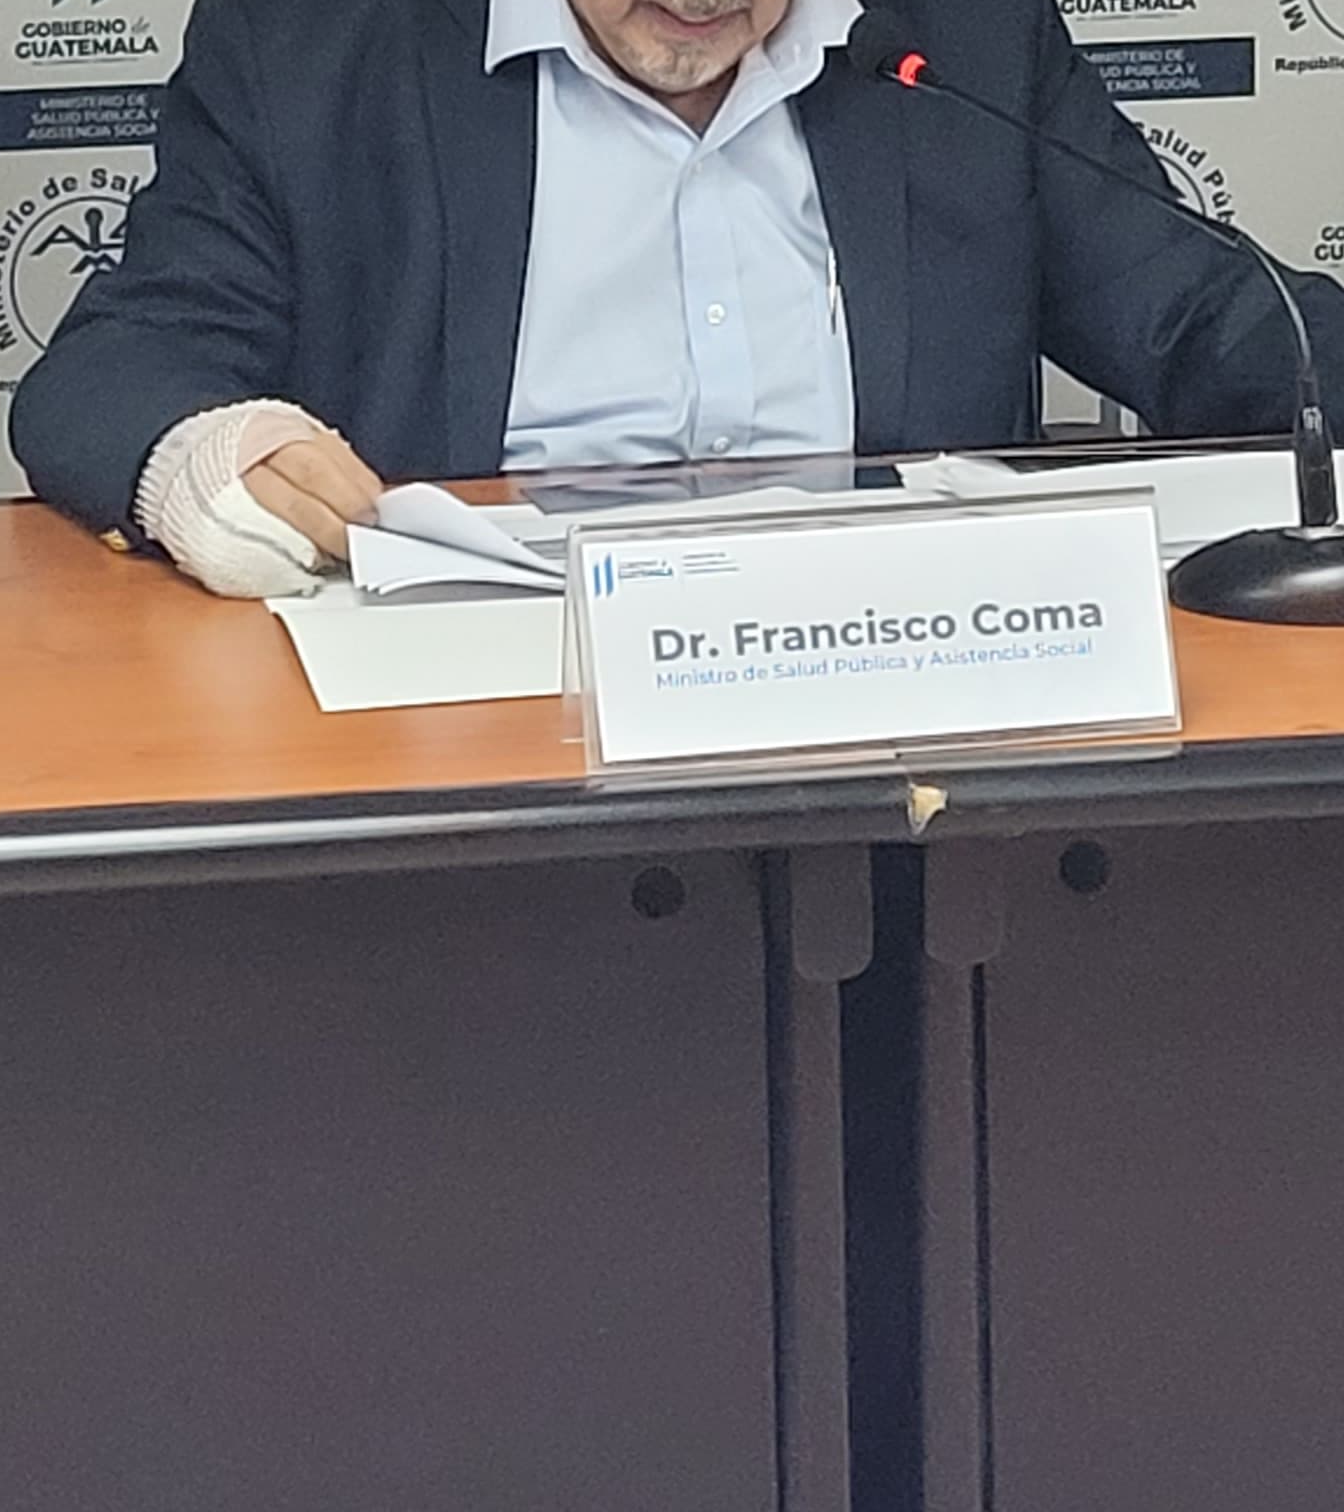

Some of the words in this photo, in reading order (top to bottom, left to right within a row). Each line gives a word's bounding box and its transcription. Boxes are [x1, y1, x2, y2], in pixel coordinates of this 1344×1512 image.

[652, 628, 719, 662] Dr.
[733, 608, 956, 656] Francisco
[971, 602, 1103, 636] Coma
[656, 667, 737, 688] Ministro
[743, 665, 768, 681] de
[773, 660, 827, 679] Salud
[914, 655, 925, 671] y
[930, 644, 1029, 665] Asistencia
[1035, 638, 1093, 658] Social
